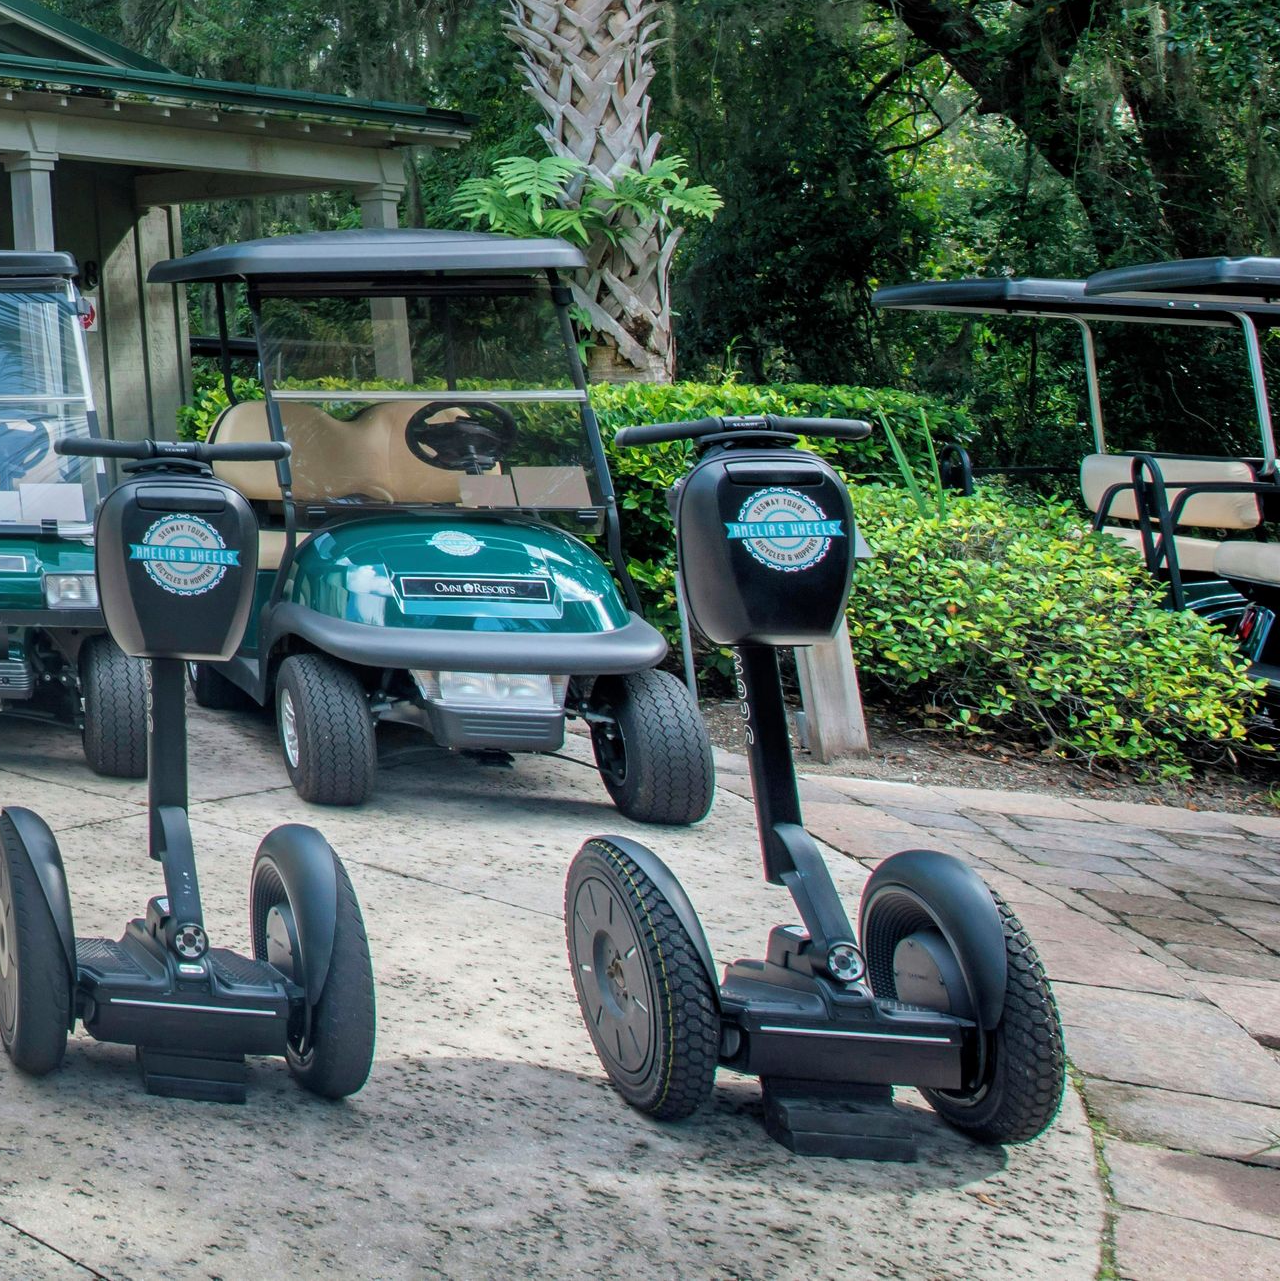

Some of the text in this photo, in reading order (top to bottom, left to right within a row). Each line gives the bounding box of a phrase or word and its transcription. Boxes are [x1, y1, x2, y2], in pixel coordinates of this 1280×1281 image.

[753, 499, 807, 515] SEGWAY TOURS
[158, 525, 209, 542] SEGWAY TOURS
[790, 523, 837, 536] WHEELS
[190, 550, 234, 564] WHEELS
[756, 540, 785, 561] BICYCLES
[794, 538, 818, 560] HOPPERS
[155, 562, 181, 585] BICYCLES
[190, 565, 214, 585] HOPPERS
[435, 582, 516, 594] OMNI RESORTS
